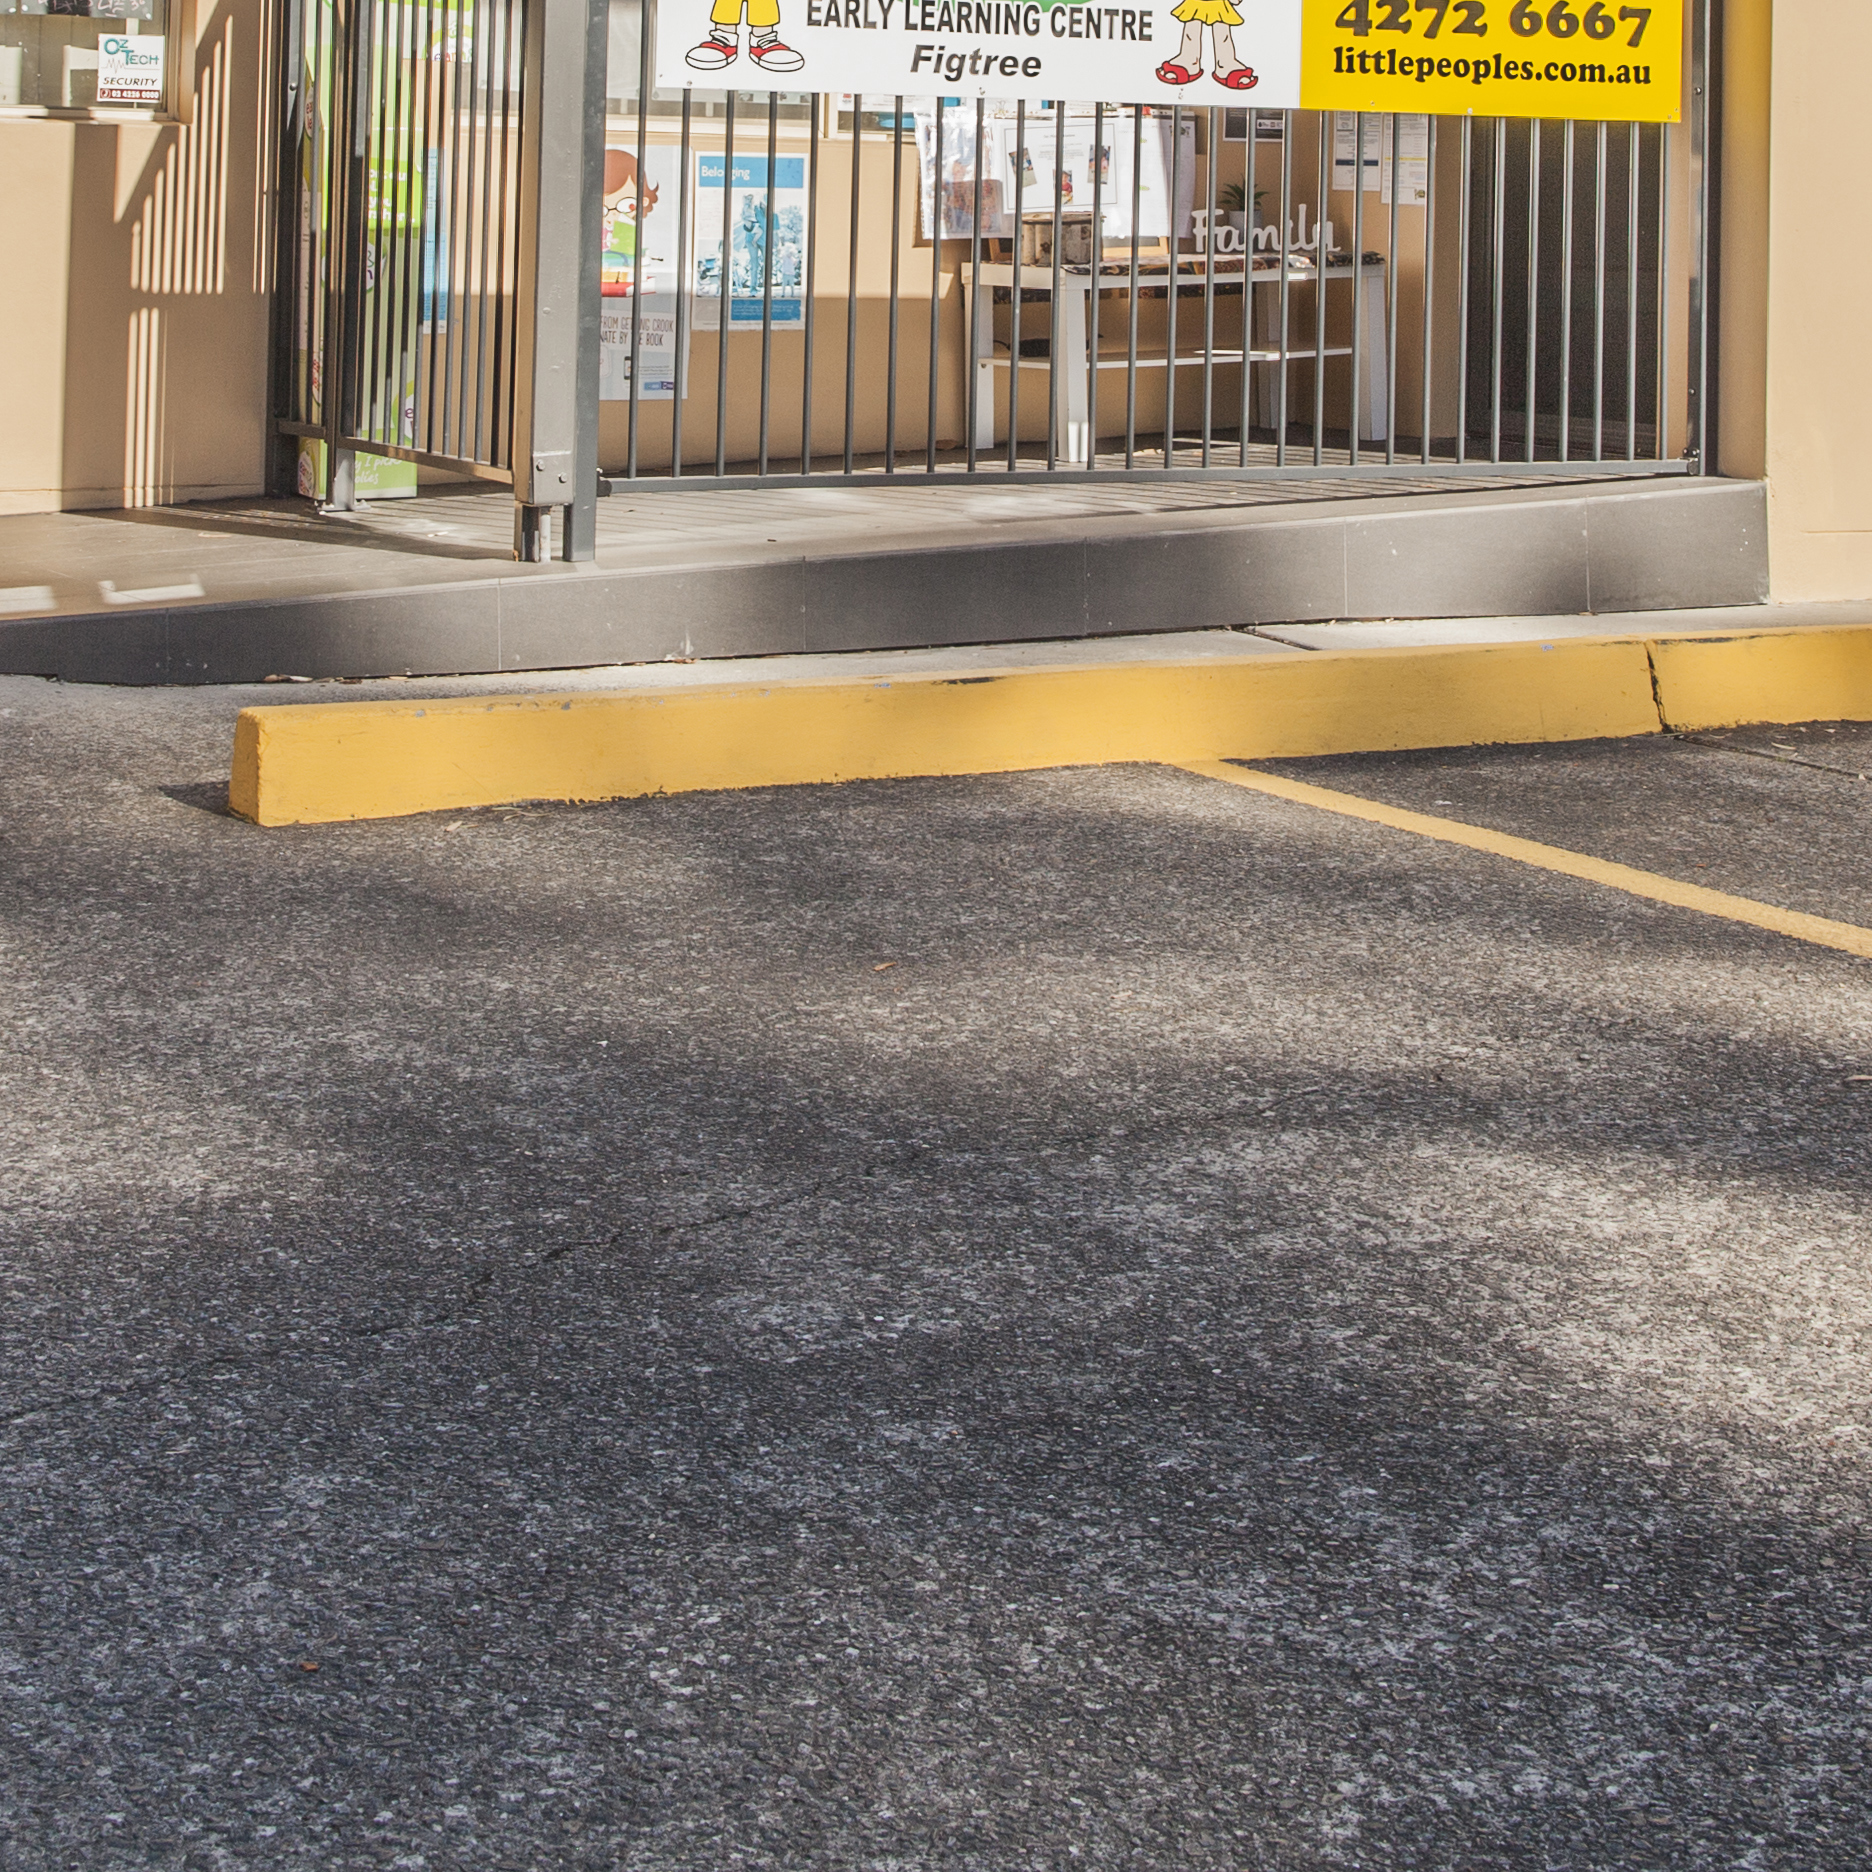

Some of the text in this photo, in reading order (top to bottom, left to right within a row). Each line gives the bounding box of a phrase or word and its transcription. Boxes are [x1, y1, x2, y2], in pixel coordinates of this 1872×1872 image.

[1050, 6, 1153, 41] CENTRE
[910, 43, 1042, 82] Figtree
[1333, 46, 1652, 86] littlepeoples.com.au
[103, 77, 158, 86] SECURITY
[111, 89, 121, 98] 02
[141, 91, 159, 99] 0000
[701, 165, 751, 181] Beloging
[600, 315, 674, 332] FROM GETNG CROOK
[619, 331, 628, 344] BY
[646, 333, 664, 346] BOOK
